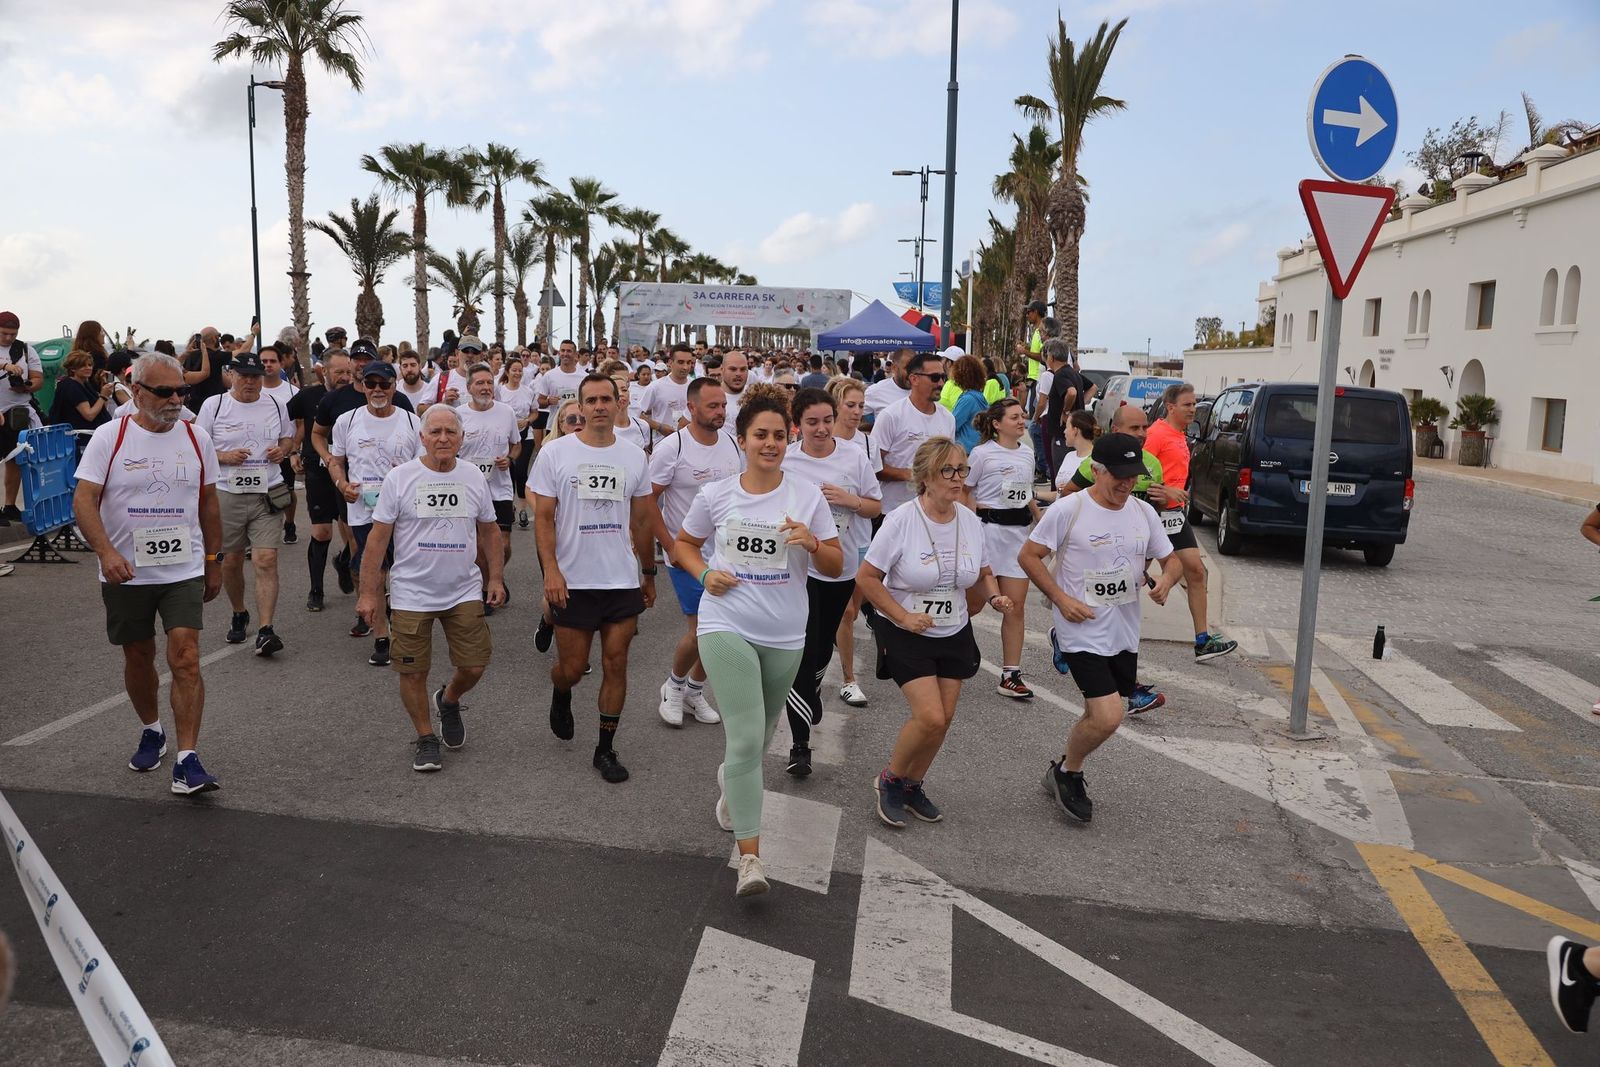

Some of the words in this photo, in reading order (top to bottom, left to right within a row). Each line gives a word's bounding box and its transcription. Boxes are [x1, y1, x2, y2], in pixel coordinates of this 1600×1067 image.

[693, 291, 706, 300] 3A
[709, 292, 759, 301] CARRERA
[762, 294, 776, 302] 5K
[840, 337, 913, 346] info@dorsalchip.es
[476, 464, 493, 473] 07
[235, 476, 261, 486] 295
[588, 475, 617, 490] 371
[1334, 484, 1352, 493] HNR
[427, 493, 459, 507] 370
[1007, 490, 1027, 500] 216
[1161, 517, 1183, 528] 1023
[145, 539, 182, 554] 392
[736, 536, 777, 554] 883
[780, 572, 791, 580] VIDA
[1094, 579, 1127, 596] 984
[922, 600, 952, 615] 778
